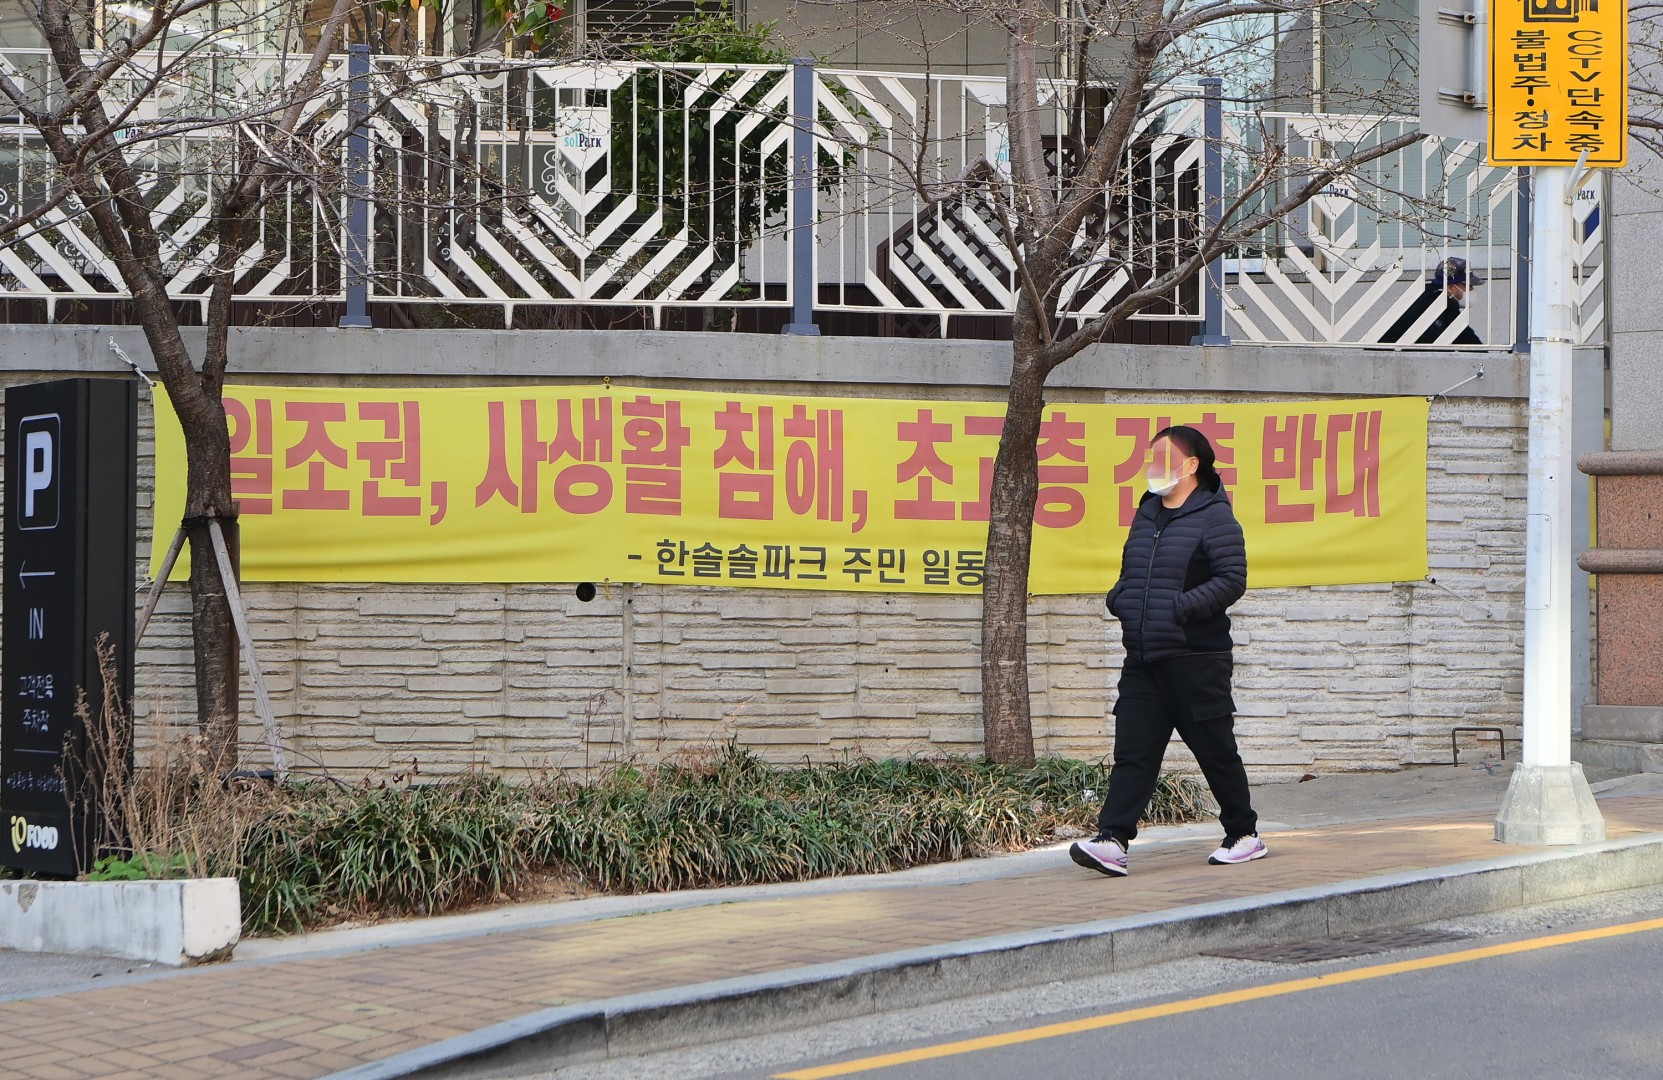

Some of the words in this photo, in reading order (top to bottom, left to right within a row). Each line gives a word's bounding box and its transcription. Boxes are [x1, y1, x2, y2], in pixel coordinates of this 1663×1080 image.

[25, 431, 54, 518] P
[223, 396, 448, 526] 일조권,
[475, 395, 690, 516] 사생활
[713, 400, 868, 534] 침해,
[1262, 410, 1383, 524] 반대
[656, 538, 828, 580] 한솔솔파크
[841, 547, 906, 584] 주민
[922, 548, 985, 587] 일동
[29, 607, 44, 641] IN
[19, 673, 54, 699] 고객전용
[22, 708, 51, 734] 주차장
